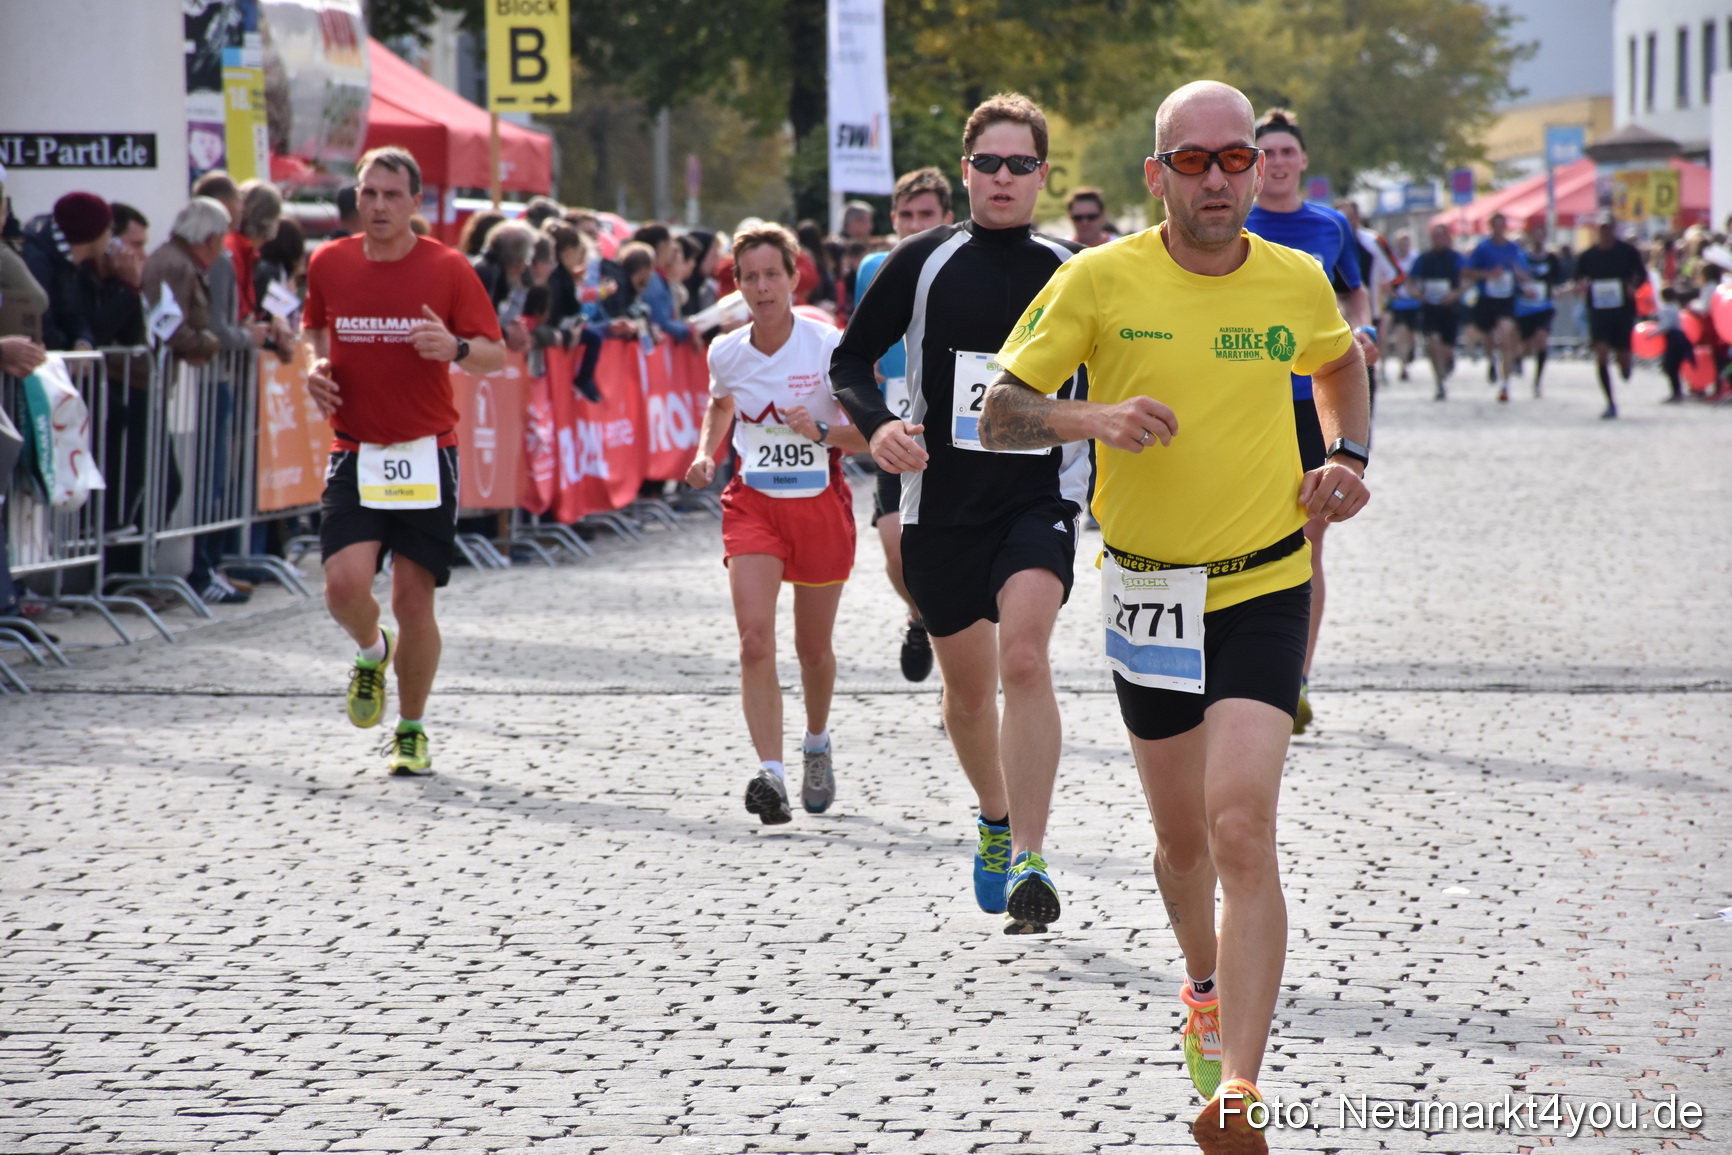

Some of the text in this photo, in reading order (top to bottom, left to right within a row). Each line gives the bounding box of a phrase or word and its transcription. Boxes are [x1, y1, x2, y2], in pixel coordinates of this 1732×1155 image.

[497, 0, 559, 16] Block
[509, 26, 548, 83] B
[1046, 166, 1068, 199] C
[1655, 184, 1674, 208] D
[1119, 328, 1173, 341] GONSO
[1221, 333, 1264, 349] BIKE
[1215, 350, 1260, 359] MARATHON
[957, 405, 964, 413] C
[757, 443, 814, 468] 2495
[383, 459, 411, 480] 50
[773, 475, 798, 485] Helen
[1113, 554, 1159, 572] queezy
[1207, 559, 1247, 576] eezy
[1113, 594, 1184, 639] 2771
[1196, 983, 1206, 992] R
